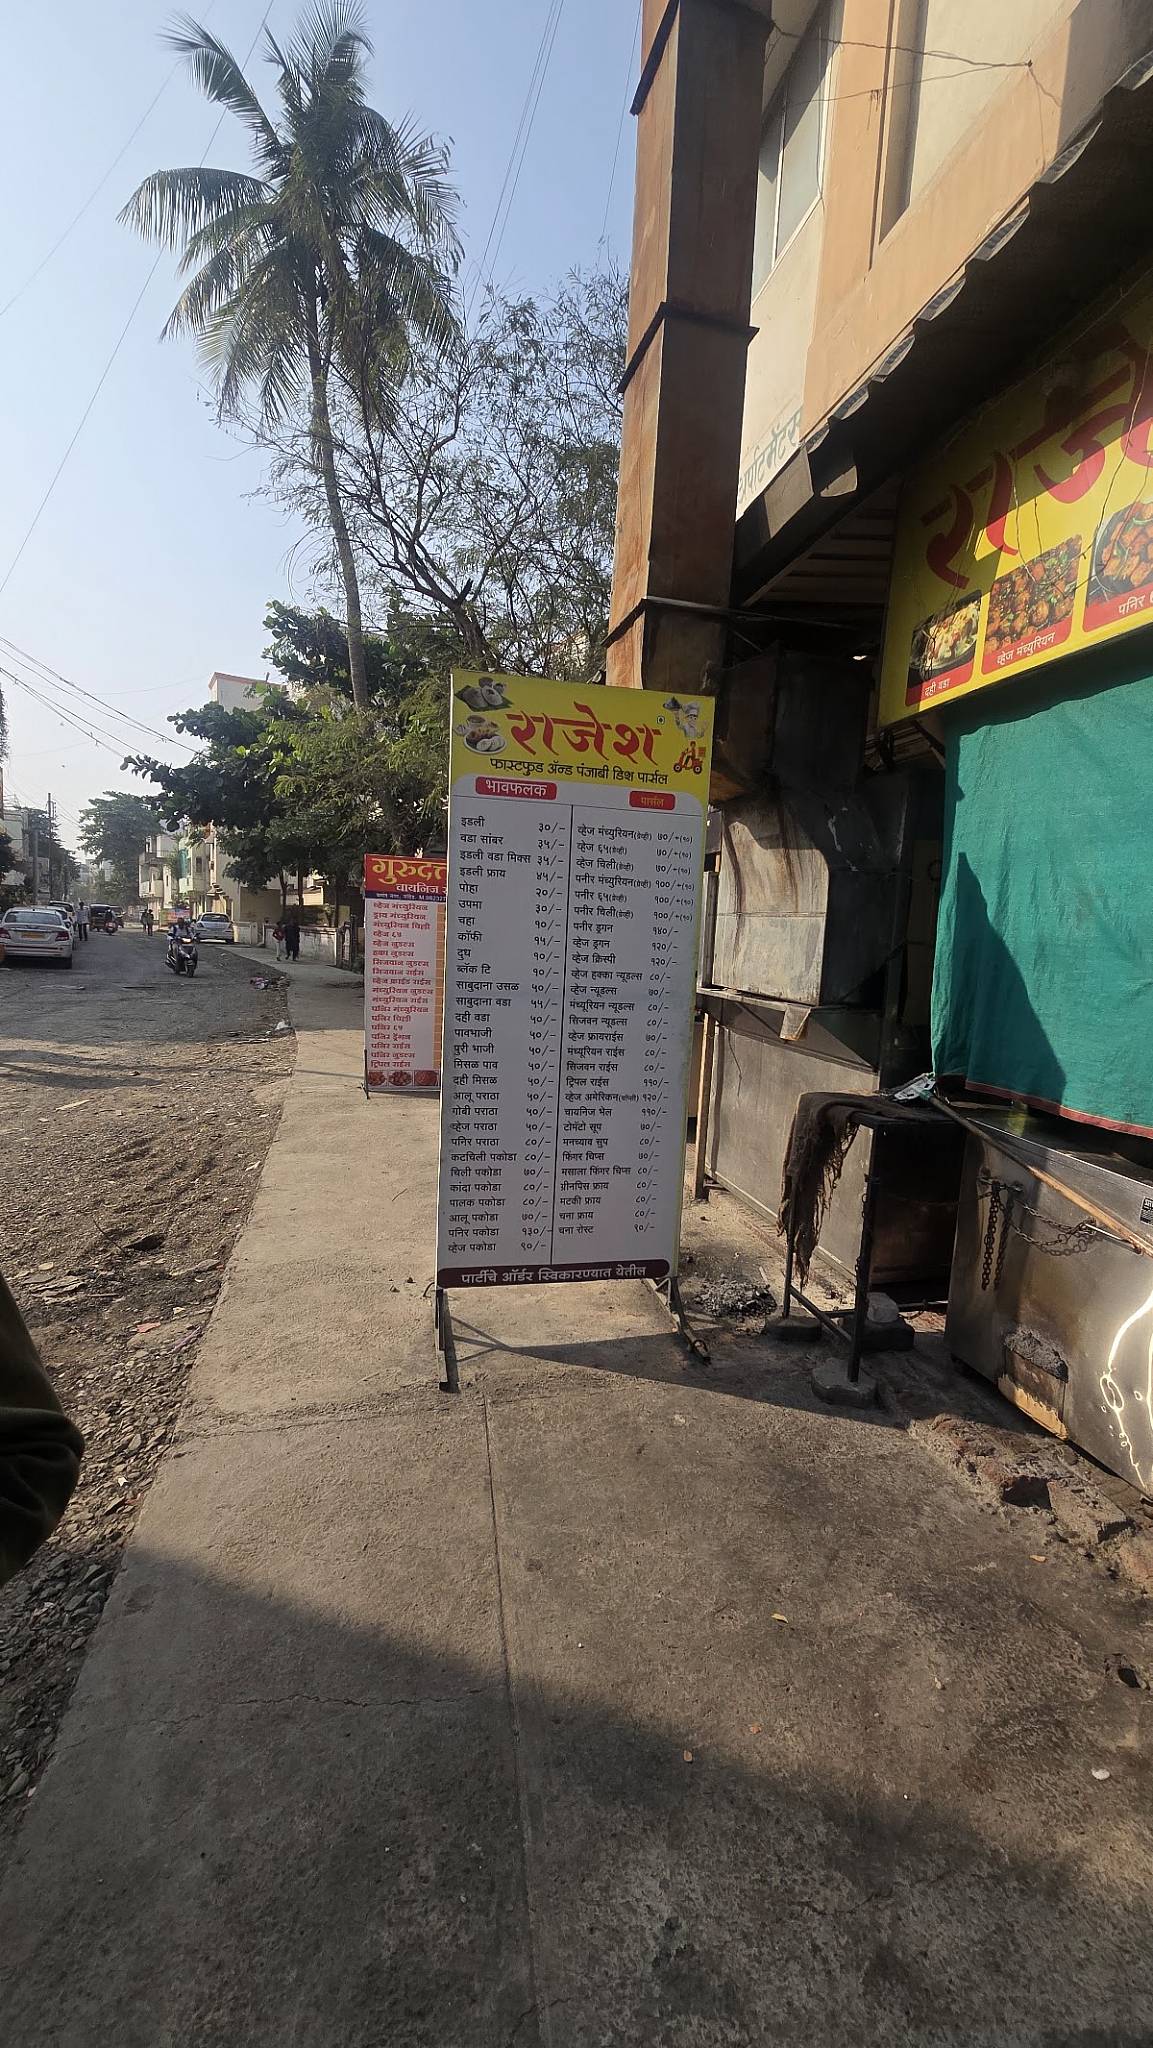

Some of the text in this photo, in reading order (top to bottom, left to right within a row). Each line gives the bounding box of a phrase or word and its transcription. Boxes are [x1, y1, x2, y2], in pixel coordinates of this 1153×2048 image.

[1118, 595, 1146, 615] पनिर
[506, 701, 663, 765] राजेश
[490, 758, 544, 776] फास्टफुड
[578, 762, 609, 780] पंजाबी
[613, 767, 634, 783] डिश
[638, 769, 669, 785] पार्सल
[485, 779, 547, 797] भावफलक
[461, 816, 485, 827] इडली
[460, 834, 477, 843] वडा
[480, 833, 504, 845] सांबर
[460, 848, 484, 860] इडली
[487, 852, 504, 861] वडा
[507, 851, 531, 863] मिक्स
[459, 865, 484, 877] इडली
[487, 869, 506, 878] फ्राय
[459, 880, 479, 894] पोहा
[458, 900, 482, 909] उपमा
[458, 917, 476, 926] चहा
[457, 930, 483, 942] कॉफी
[457, 948, 471, 960] दुध
[456, 963, 478, 973] ब्लॅक
[481, 963, 491, 974] टि
[456, 981, 493, 992] साबुदाना
[456, 997, 492, 1008] साबुदाना
[495, 998, 512, 1006] वडा
[455, 1011, 471, 1023] दही
[474, 1014, 490, 1022] वडा
[454, 1027, 493, 1038] पावभाजी
[454, 1042, 469, 1055] पुरी
[472, 1042, 494, 1054] भाजी
[453, 1058, 480, 1069] मिसळ
[483, 1061, 499, 1070] पाव
[452, 1073, 469, 1086] दही
[472, 1074, 498, 1084] मिसळ
[453, 1092, 474, 1104] आलू
[475, 1092, 500, 1100] पराठा
[451, 1105, 471, 1115] गोबी
[474, 1108, 498, 1116] पराठा
[450, 1120, 470, 1133] व्हेज
[474, 1123, 497, 1131] पराठा
[450, 1136, 472, 1146] पनिर
[475, 1138, 500, 1146] पराठा
[489, 1150, 517, 1161] पकोडा
[450, 1166, 472, 1177] चिली
[475, 1165, 502, 1176] पकोडा
[449, 1181, 473, 1192] कांदा
[474, 1181, 502, 1192] पकोडा
[450, 1199, 475, 1207] पालक
[478, 1196, 506, 1206] पकोडा
[449, 1214, 470, 1225] आलू
[472, 1211, 499, 1222] पकोडा
[448, 1225, 499, 1237] पनिर पकोडा
[448, 1242, 466, 1253] व्हेज
[470, 1241, 496, 1251] पकोडा
[461, 1264, 646, 1285] पार्टीचे ऑर्डर स्विकारण्यात येतील
